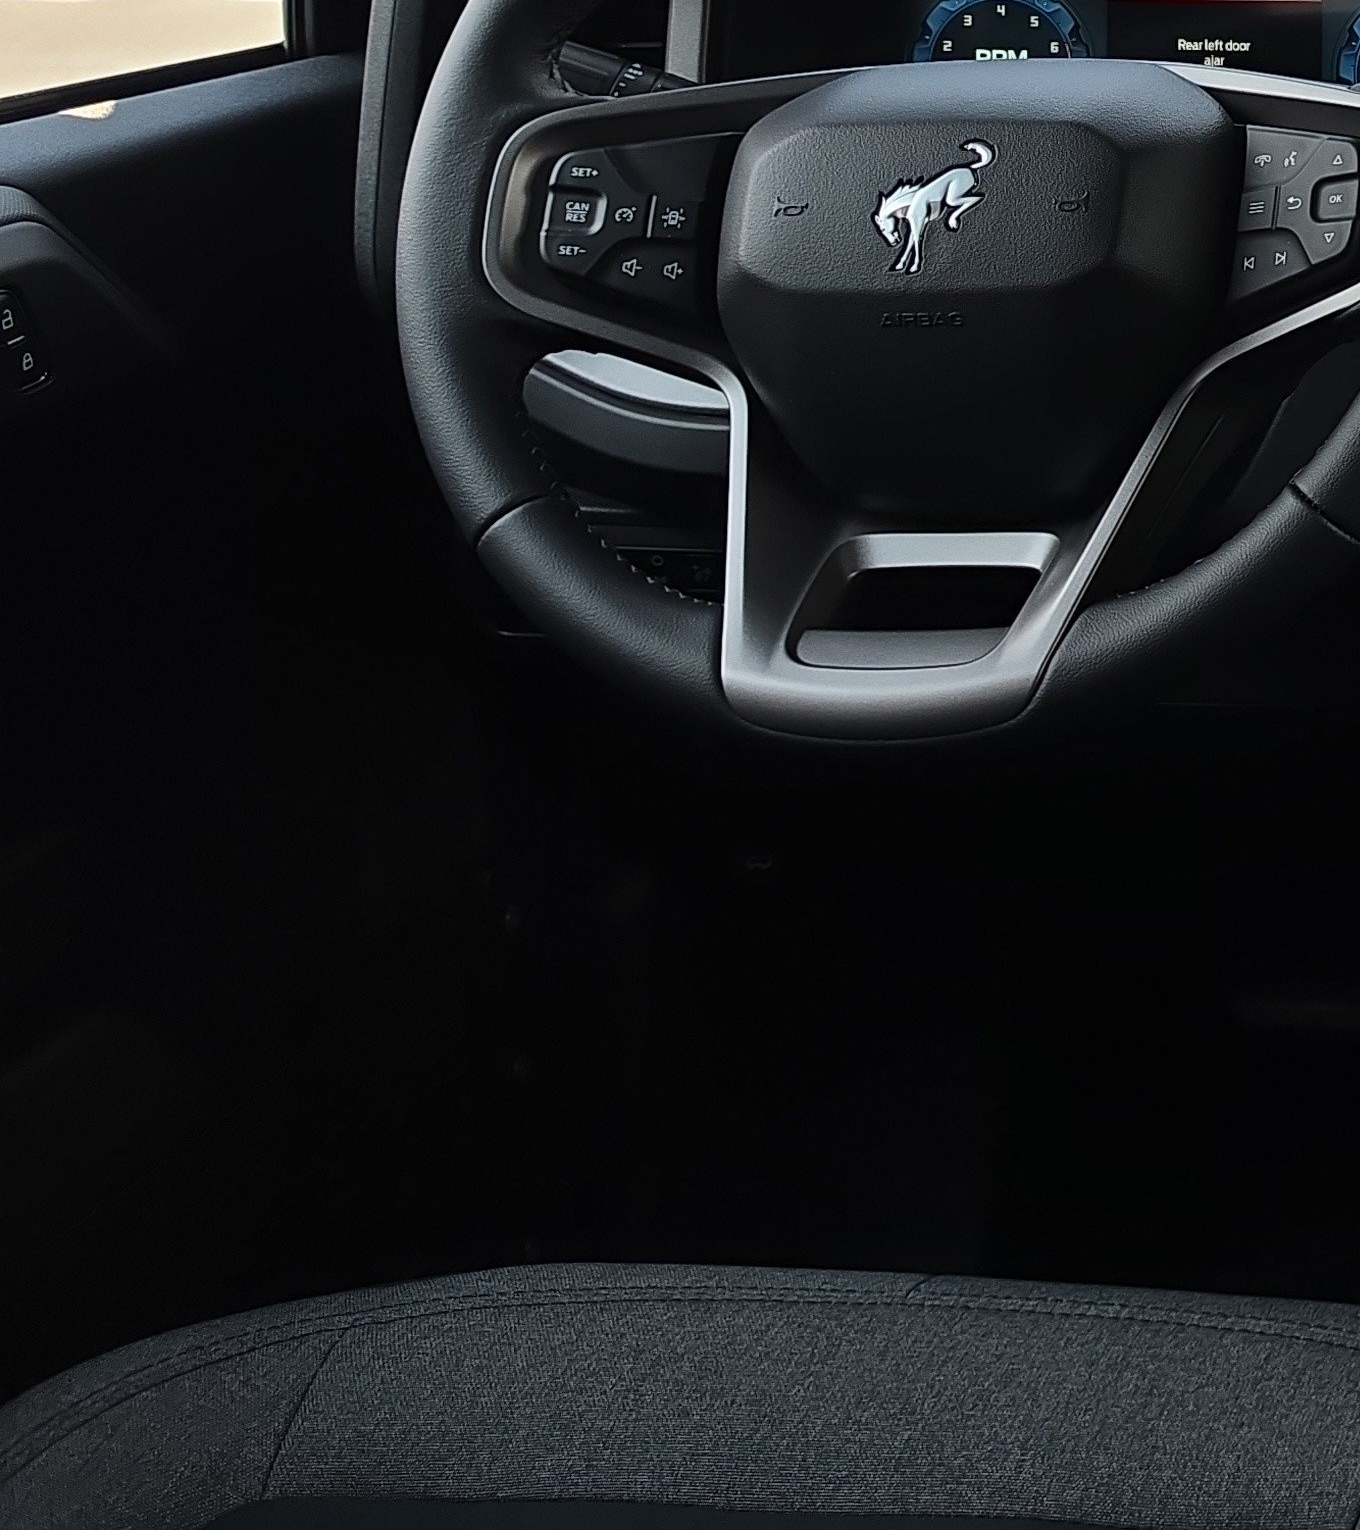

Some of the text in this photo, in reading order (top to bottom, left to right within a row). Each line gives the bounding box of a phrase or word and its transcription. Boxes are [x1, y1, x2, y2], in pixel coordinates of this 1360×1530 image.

[997, 4, 1005, 17] 4
[963, 15, 972, 26] 3
[1030, 16, 1039, 27] 5
[943, 40, 952, 52] 2
[1050, 41, 1059, 53] 6
[1177, 38, 1251, 52] Rear left door
[1203, 55, 1225, 68] ajar
[570, 165, 599, 179] SET+
[1328, 192, 1344, 205] OK
[564, 200, 591, 214] CAN
[564, 210, 587, 225] RES
[880, 310, 963, 329] AIRBAG
